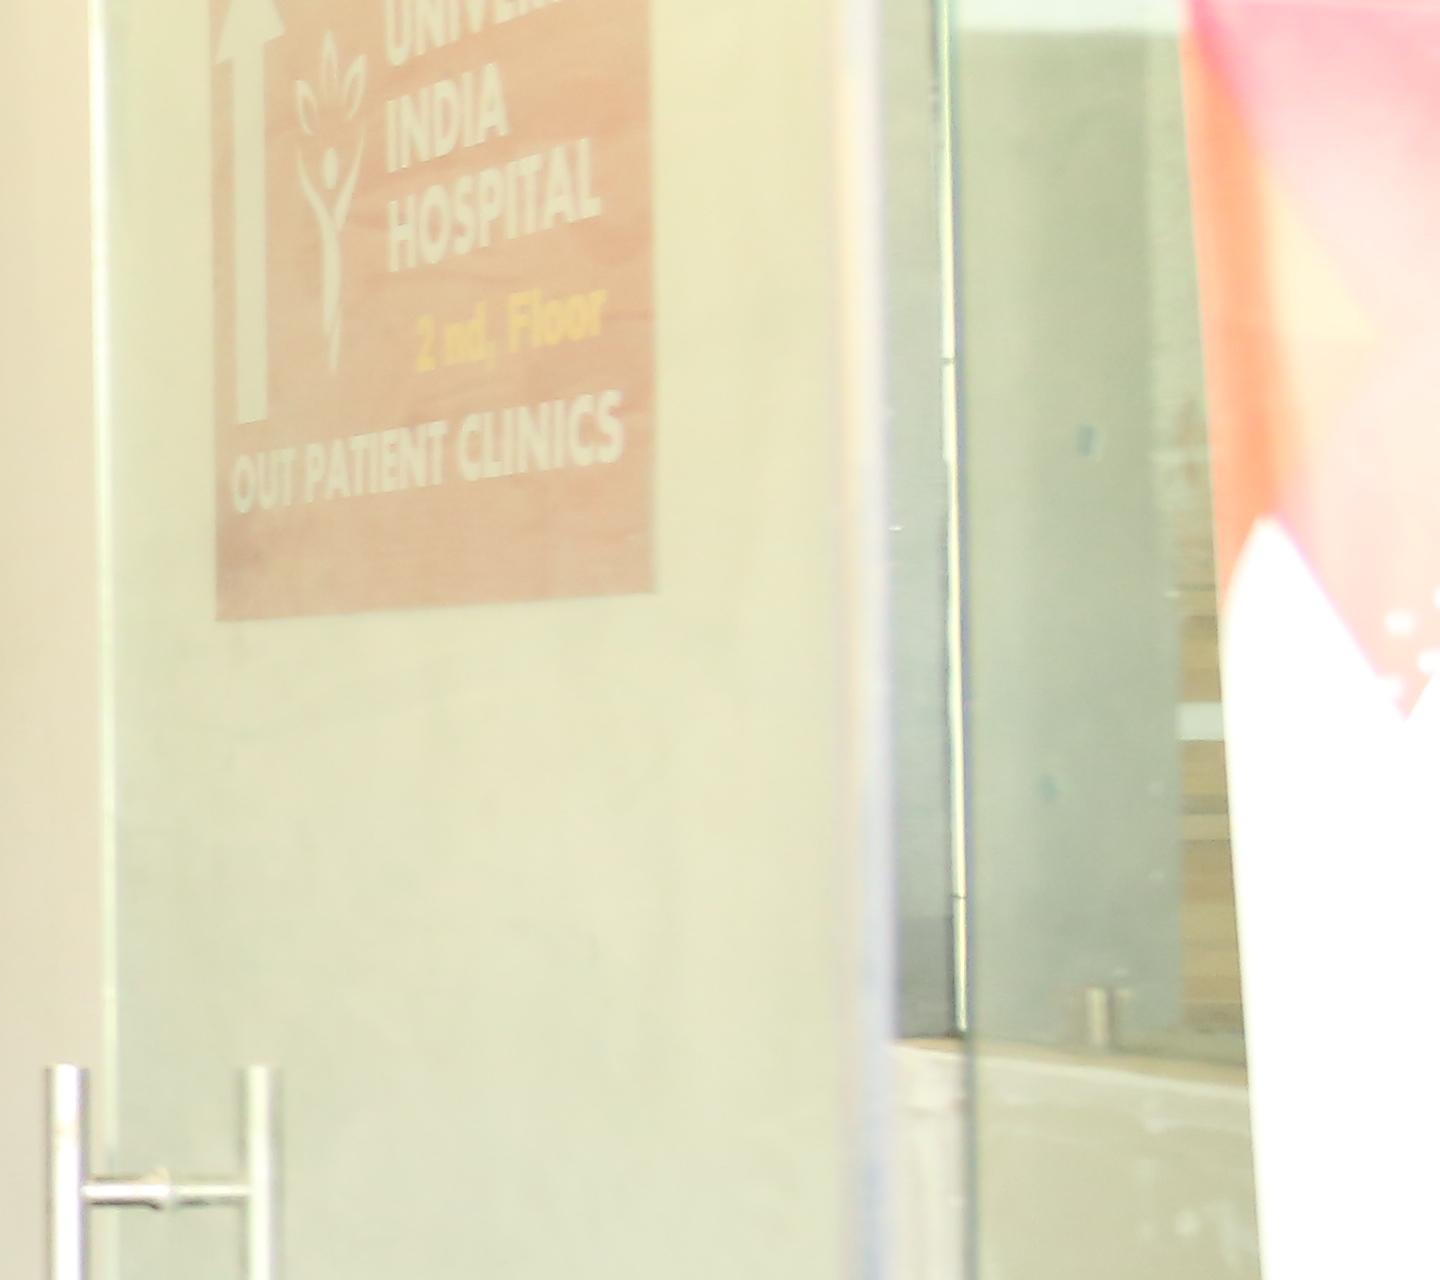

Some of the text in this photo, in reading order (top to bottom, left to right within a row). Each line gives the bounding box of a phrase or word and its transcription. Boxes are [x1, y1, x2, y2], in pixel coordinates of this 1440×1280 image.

[384, 60, 510, 173] INDIA
[385, 138, 603, 273] HOSPITAL
[416, 314, 438, 373] 2
[508, 287, 609, 354] Floor
[233, 389, 625, 514] OUT PATIENT CLINICS
